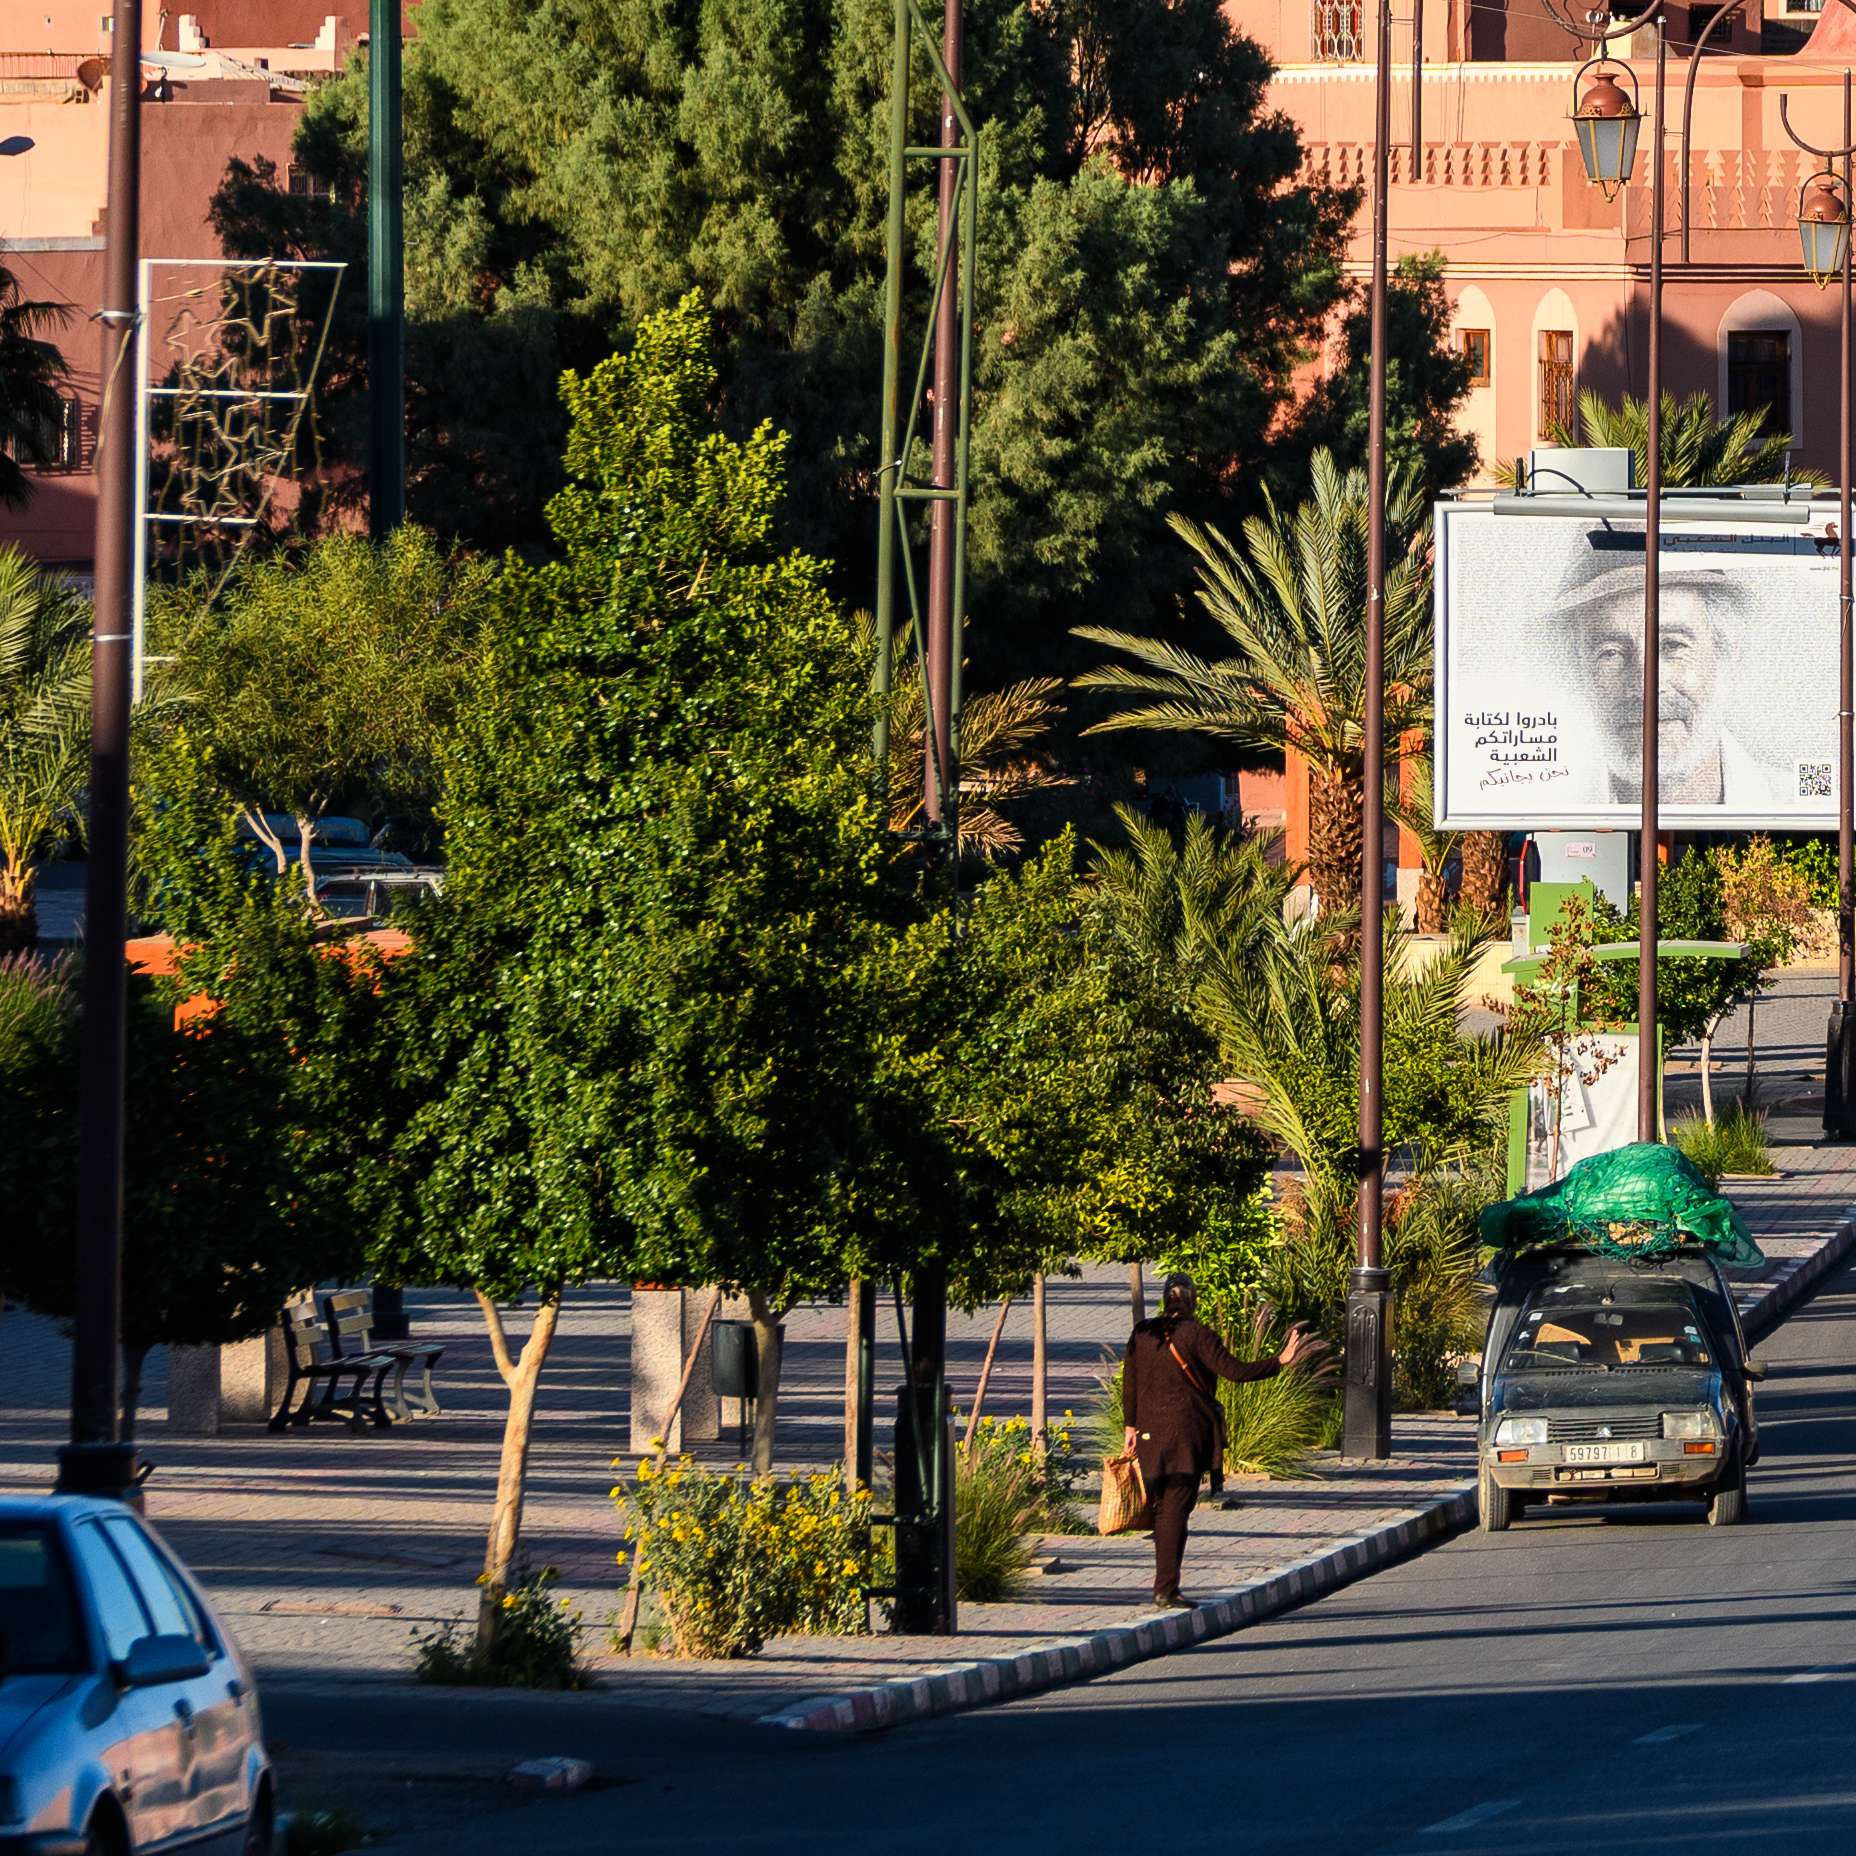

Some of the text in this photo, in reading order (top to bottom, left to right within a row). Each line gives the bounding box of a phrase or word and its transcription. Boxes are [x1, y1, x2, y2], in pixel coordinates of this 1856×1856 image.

[1464, 712, 1557, 730] بادروا لكتابة
[1475, 730, 1557, 748] مساراتكم
[1490, 747, 1557, 766] الشعبية
[1479, 765, 1569, 791] نحن بجانبكم
[1569, 1446, 1607, 1461] 59797
